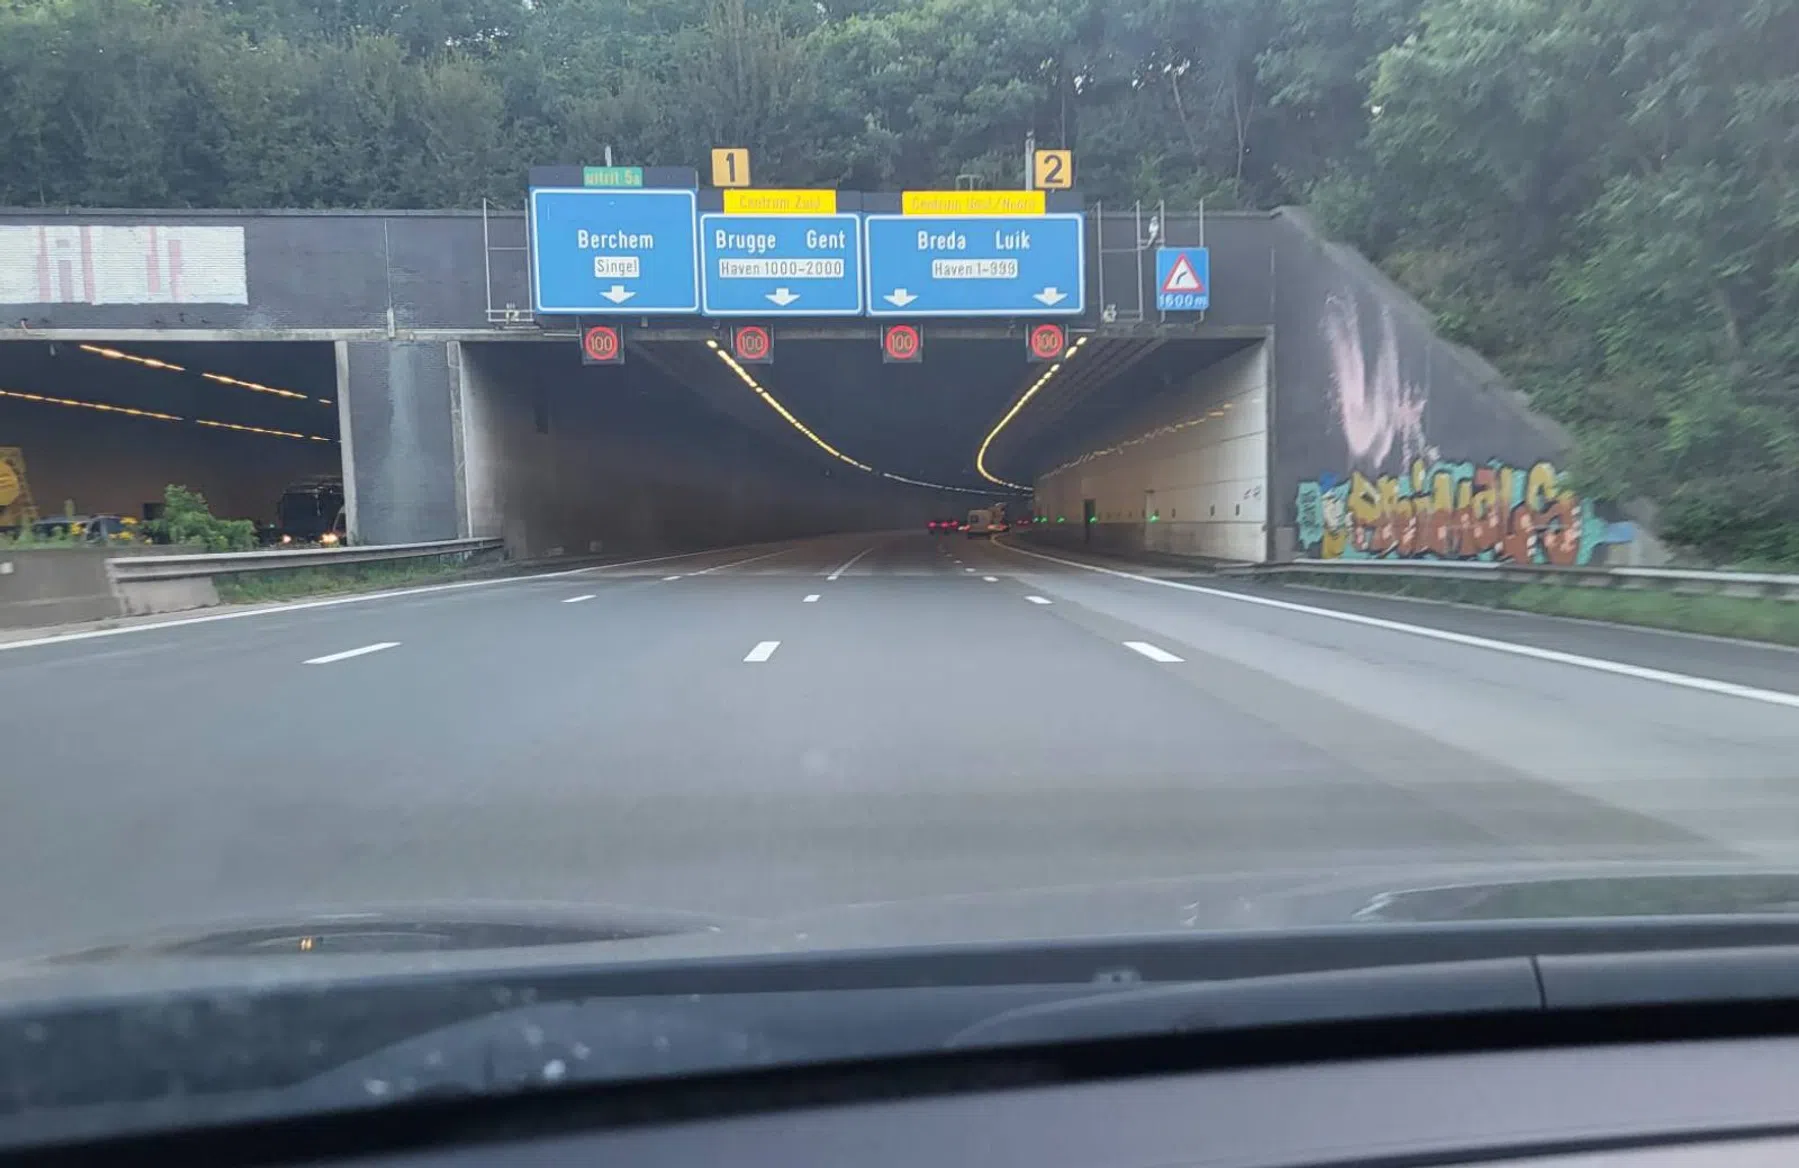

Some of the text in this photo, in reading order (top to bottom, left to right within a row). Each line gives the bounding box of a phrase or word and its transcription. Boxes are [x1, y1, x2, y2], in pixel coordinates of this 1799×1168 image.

[726, 152, 735, 183] 1
[1043, 154, 1064, 184] 2
[577, 229, 654, 249] Berchem
[715, 229, 846, 253] Brugge Gent
[917, 229, 1031, 250] Breda Luik
[596, 259, 638, 276] Singel
[721, 261, 842, 276] Haven 1000-2000
[934, 261, 1016, 277] Haven 1-999
[590, 336, 613, 351] 100
[742, 335, 764, 351] 100
[891, 334, 913, 351] 100
[1036, 333, 1058, 349] 100
